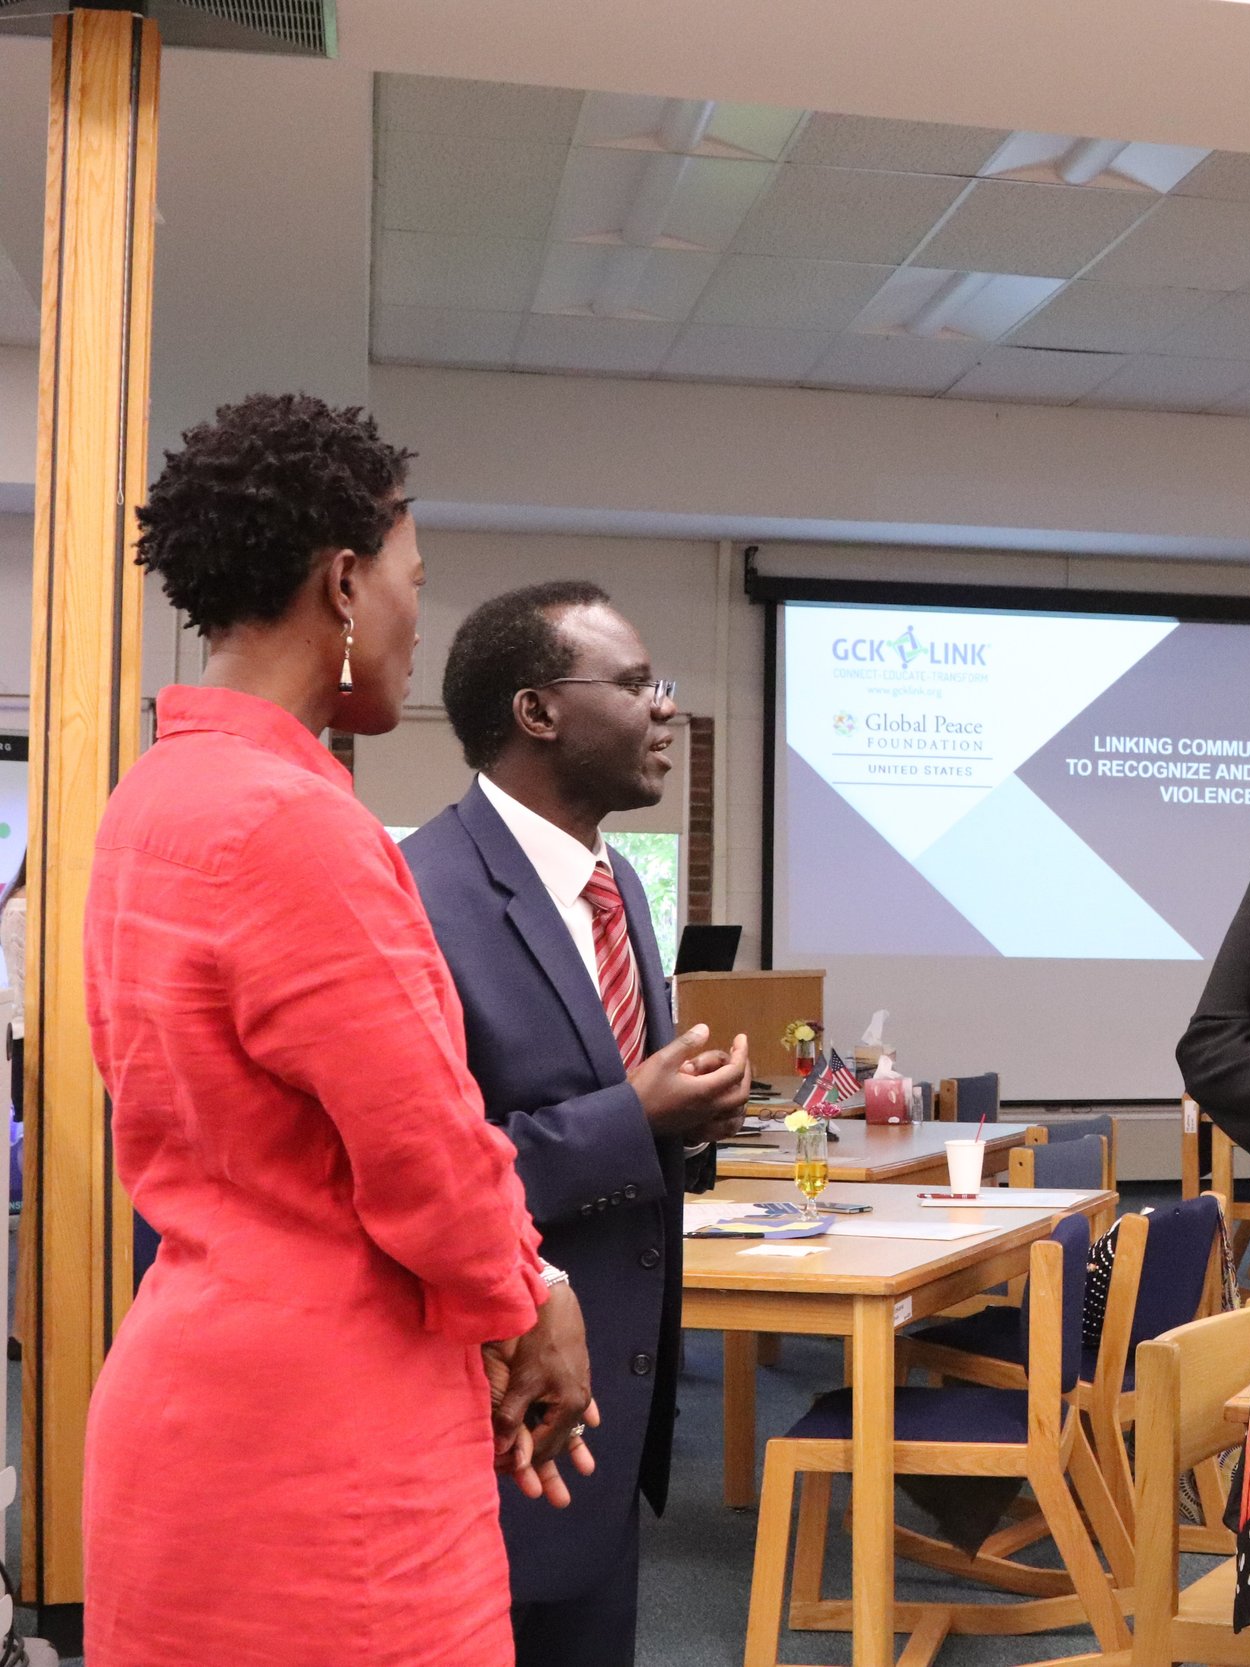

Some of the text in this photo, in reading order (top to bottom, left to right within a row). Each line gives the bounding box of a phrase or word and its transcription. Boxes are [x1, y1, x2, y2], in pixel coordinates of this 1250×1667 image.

[832, 638, 986, 666] GCK LINK
[865, 713, 983, 734] Global Peace
[867, 737, 983, 751] FOUNDATION
[1094, 735, 1173, 755] LINKING
[868, 764, 973, 776] UNITED STATES
[1065, 758, 1093, 776] TO
[1098, 759, 1211, 779] RECOGNIZE
